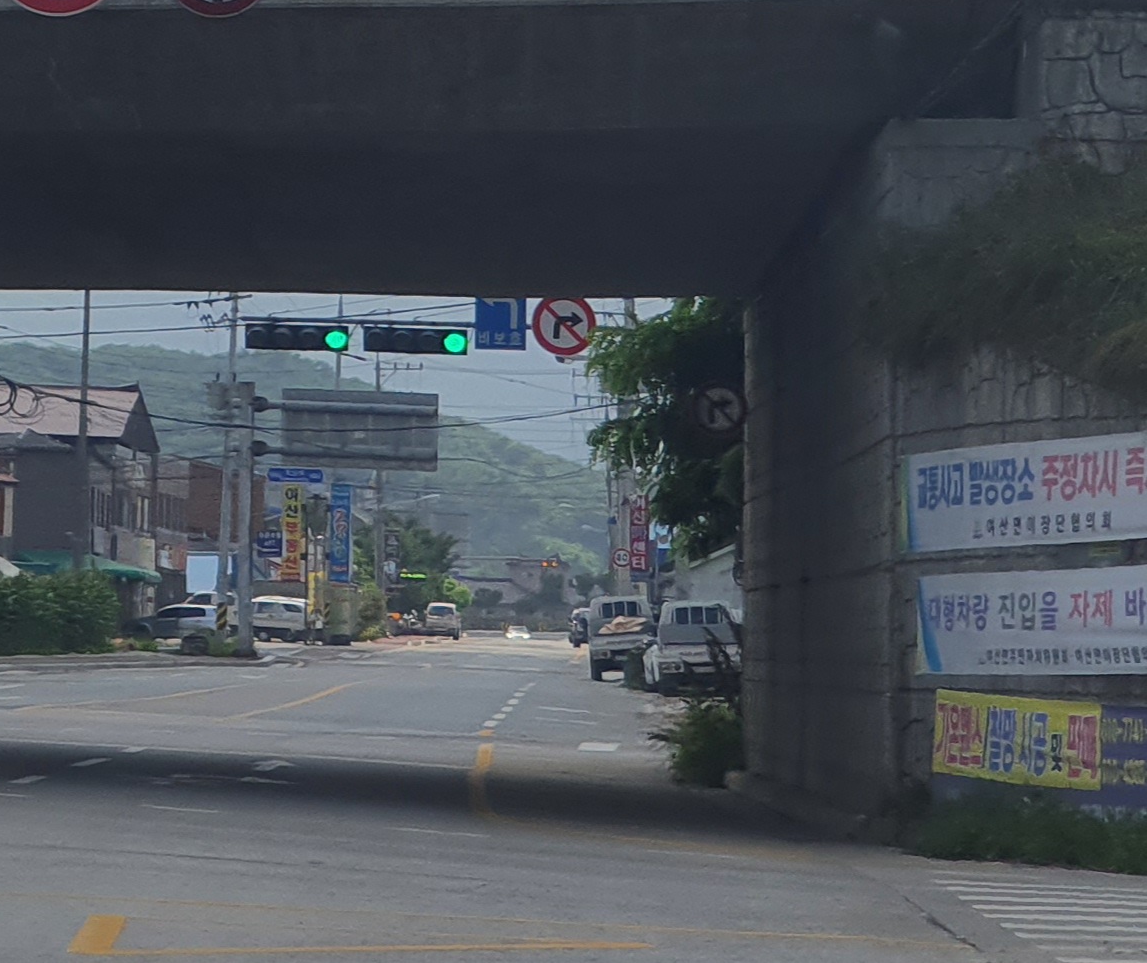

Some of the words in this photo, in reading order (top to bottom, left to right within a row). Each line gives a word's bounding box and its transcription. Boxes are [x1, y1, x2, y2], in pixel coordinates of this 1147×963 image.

[478, 332, 524, 346] 비보호
[969, 457, 1035, 506] 발생장소
[1042, 449, 1119, 502] 주정차시
[1125, 446, 1147, 495] 즉
[928, 592, 990, 631] 대형차량
[998, 590, 1059, 631] 진입을
[1069, 588, 1114, 627] 자제
